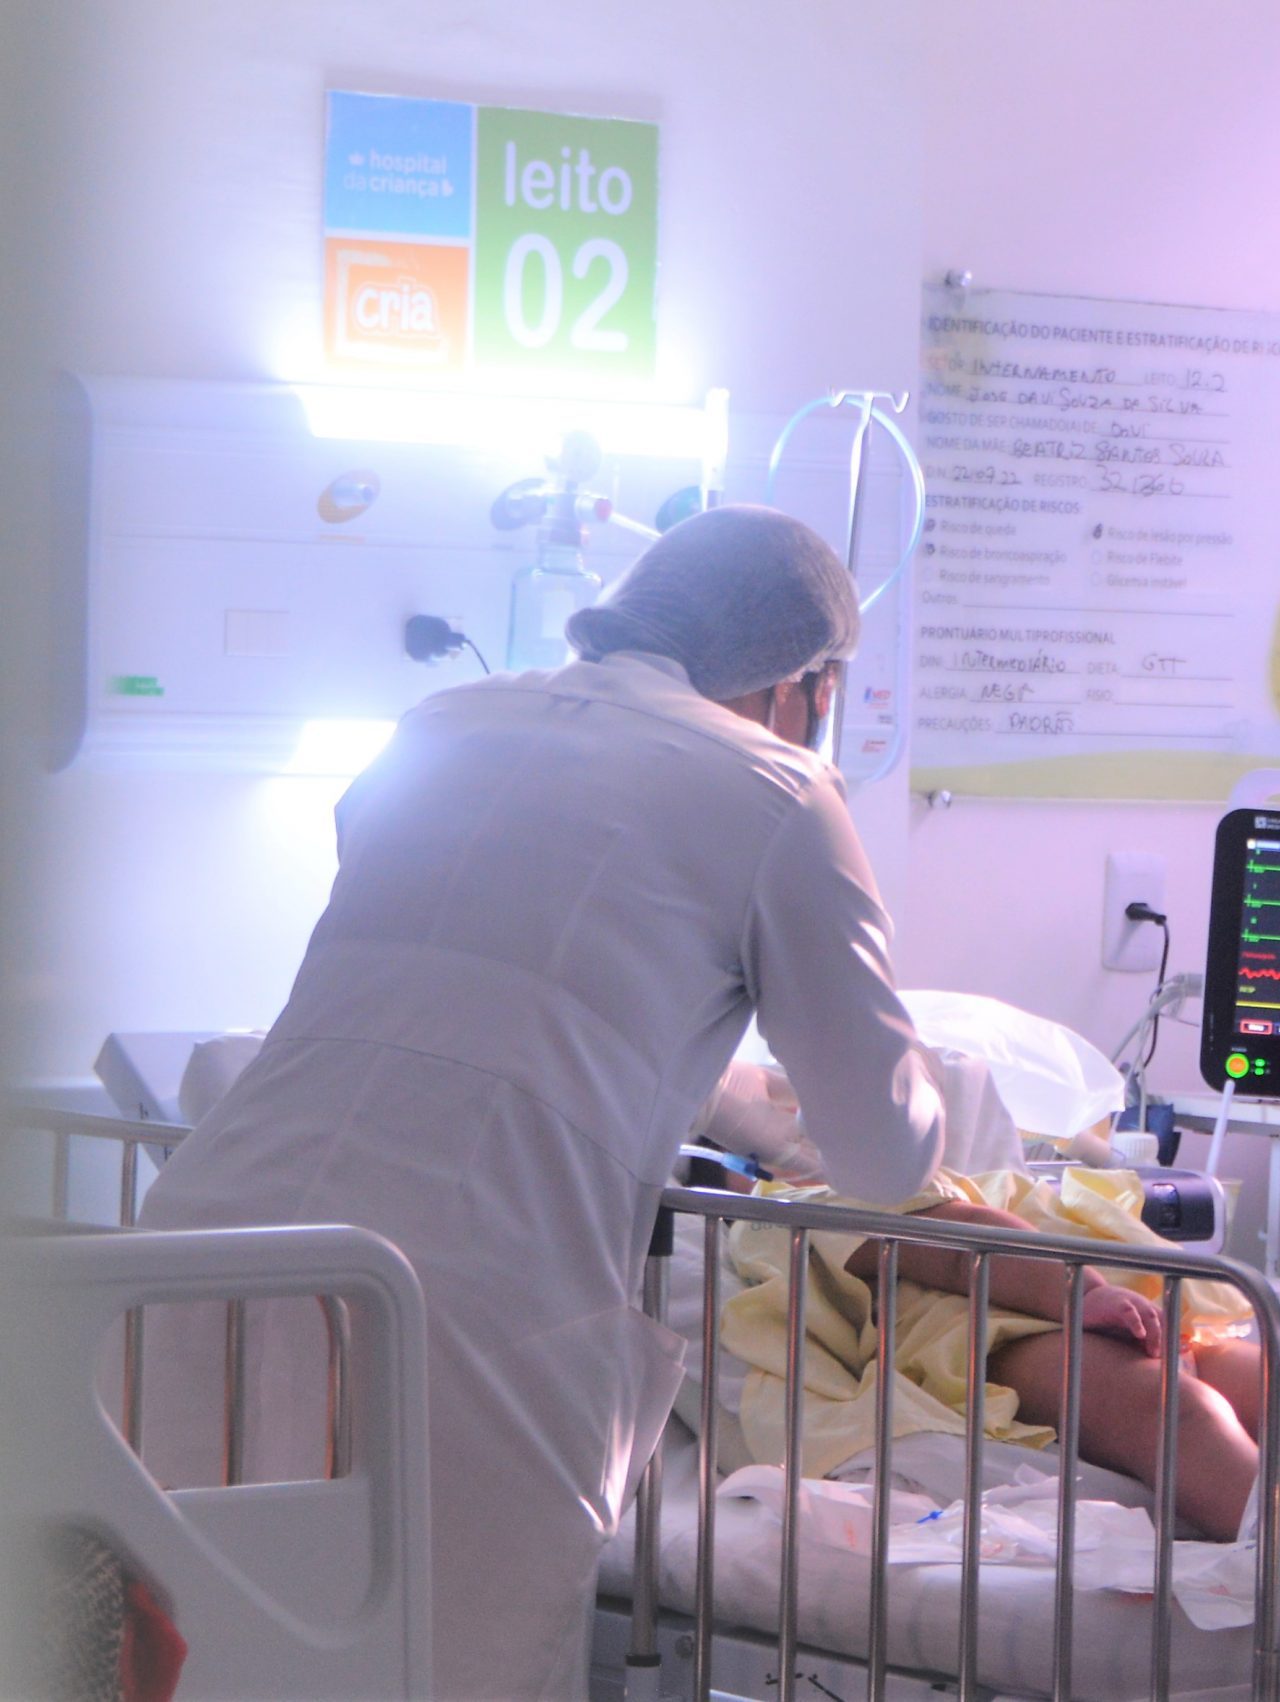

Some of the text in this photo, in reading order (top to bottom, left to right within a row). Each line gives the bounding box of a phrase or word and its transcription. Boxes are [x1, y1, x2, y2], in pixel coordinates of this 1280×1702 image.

[368, 149, 447, 177] hospital
[505, 141, 633, 216] leito
[356, 283, 434, 331] cria
[504, 232, 630, 351] 02
[927, 315, 1028, 341] IDENTIFICAÇÃO
[1030, 324, 1050, 340] DO
[1053, 327, 1113, 344] PACIENTE
[1115, 330, 1125, 344] E
[1127, 332, 1230, 354] ESTRATIFICAÇÃO
[1233, 340, 1250, 354] DE
[970, 413, 985, 426] DE
[925, 495, 1019, 513] ESTRATIFICAÇÃO
[1021, 499, 1038, 512] DE
[920, 626, 1116, 646] PRONTUÁRIO MULTIPROFISSIONAL
